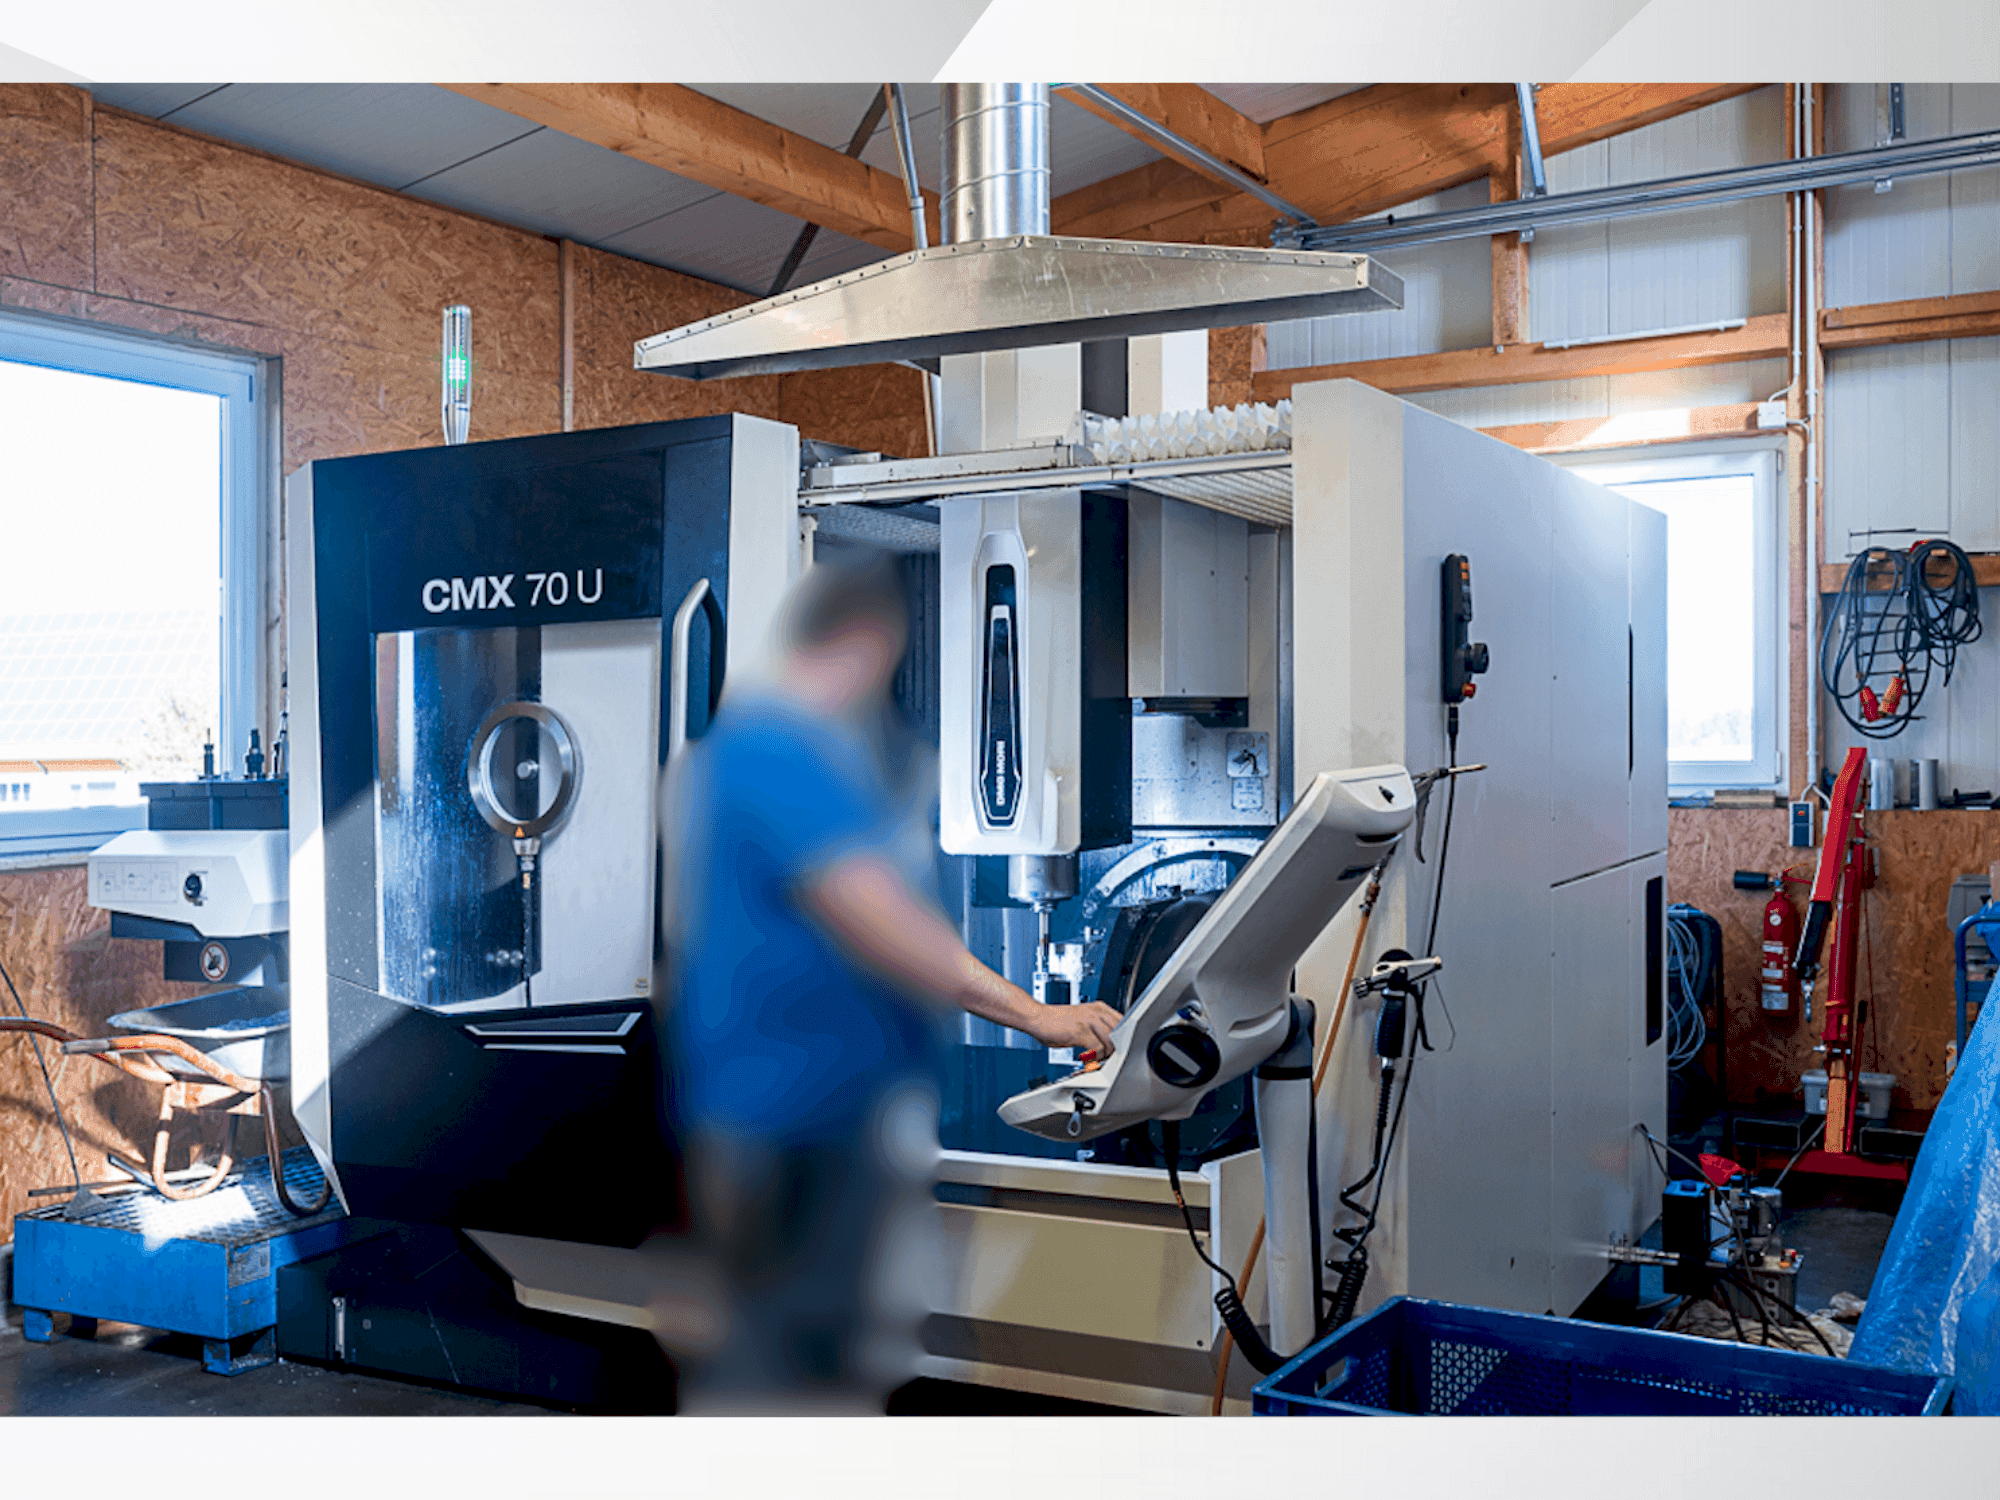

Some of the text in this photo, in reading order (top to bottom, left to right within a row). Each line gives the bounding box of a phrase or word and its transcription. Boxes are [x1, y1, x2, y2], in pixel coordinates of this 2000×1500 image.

[422, 567, 603, 614] CMX 70 U
